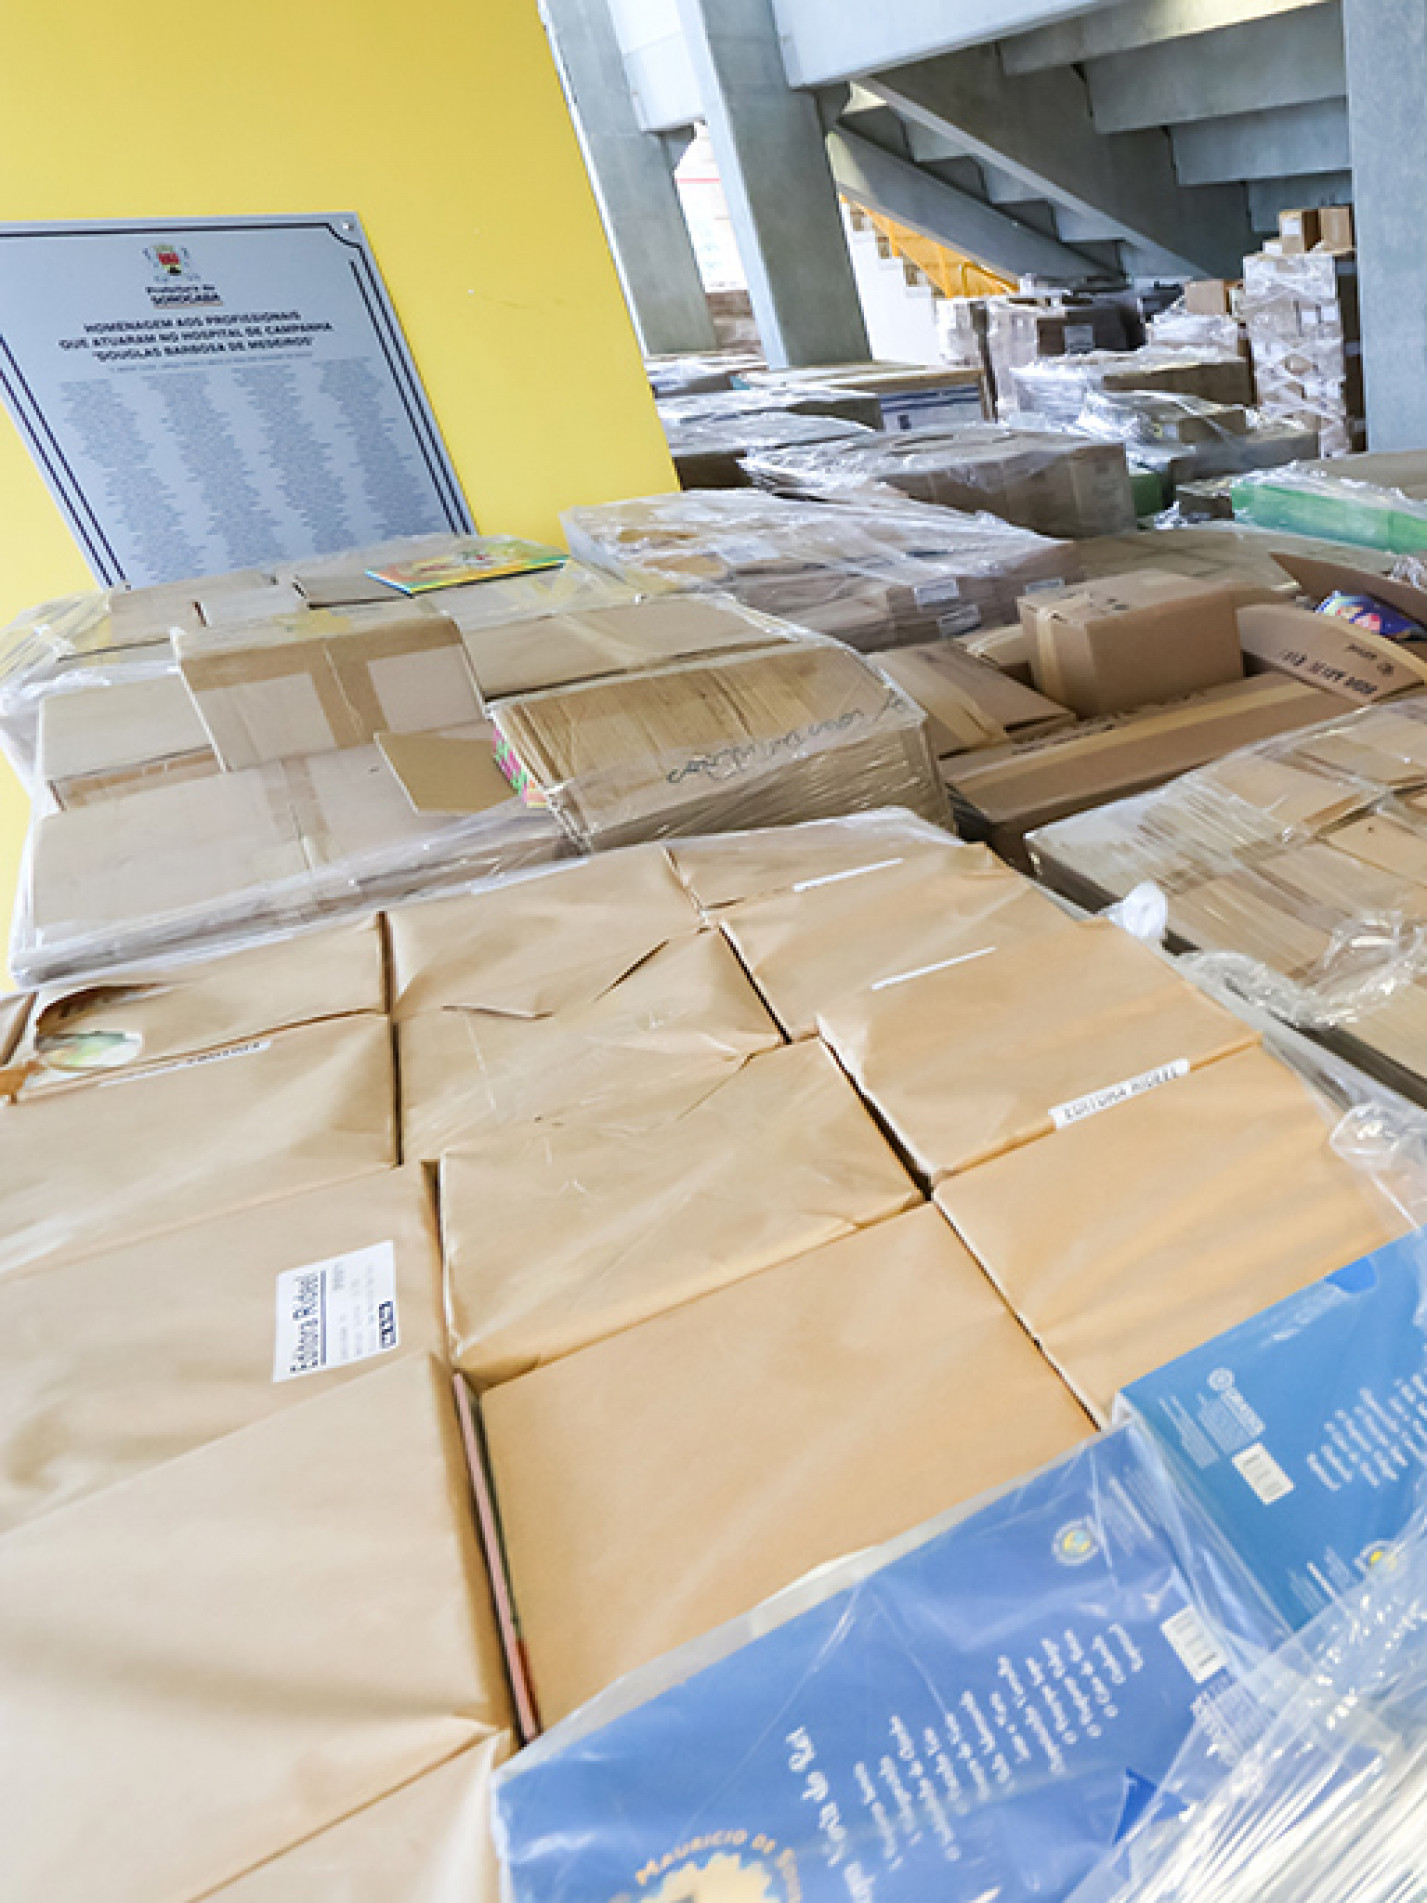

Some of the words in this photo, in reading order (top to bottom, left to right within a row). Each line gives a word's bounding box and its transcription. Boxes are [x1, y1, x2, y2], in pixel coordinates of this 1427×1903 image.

[58, 338, 89, 351] QUE
[92, 334, 156, 347] ATUARAM
[159, 332, 179, 343] NO
[181, 328, 244, 341] HOSPITAL
[245, 326, 263, 336] DE
[264, 321, 334, 335] CAMPANHA
[83, 319, 173, 333] HOMENAGEM
[176, 317, 204, 327] AOS
[205, 311, 301, 324] PROFISSIONAIS
[164, 343, 226, 356] BARBOSA
[228, 341, 245, 352] DE
[785, 1724, 816, 1773] Rei
[802, 1771, 829, 1802] do
[635, 1829, 748, 1886] MAURICIO
[752, 1832, 776, 1854] DE
